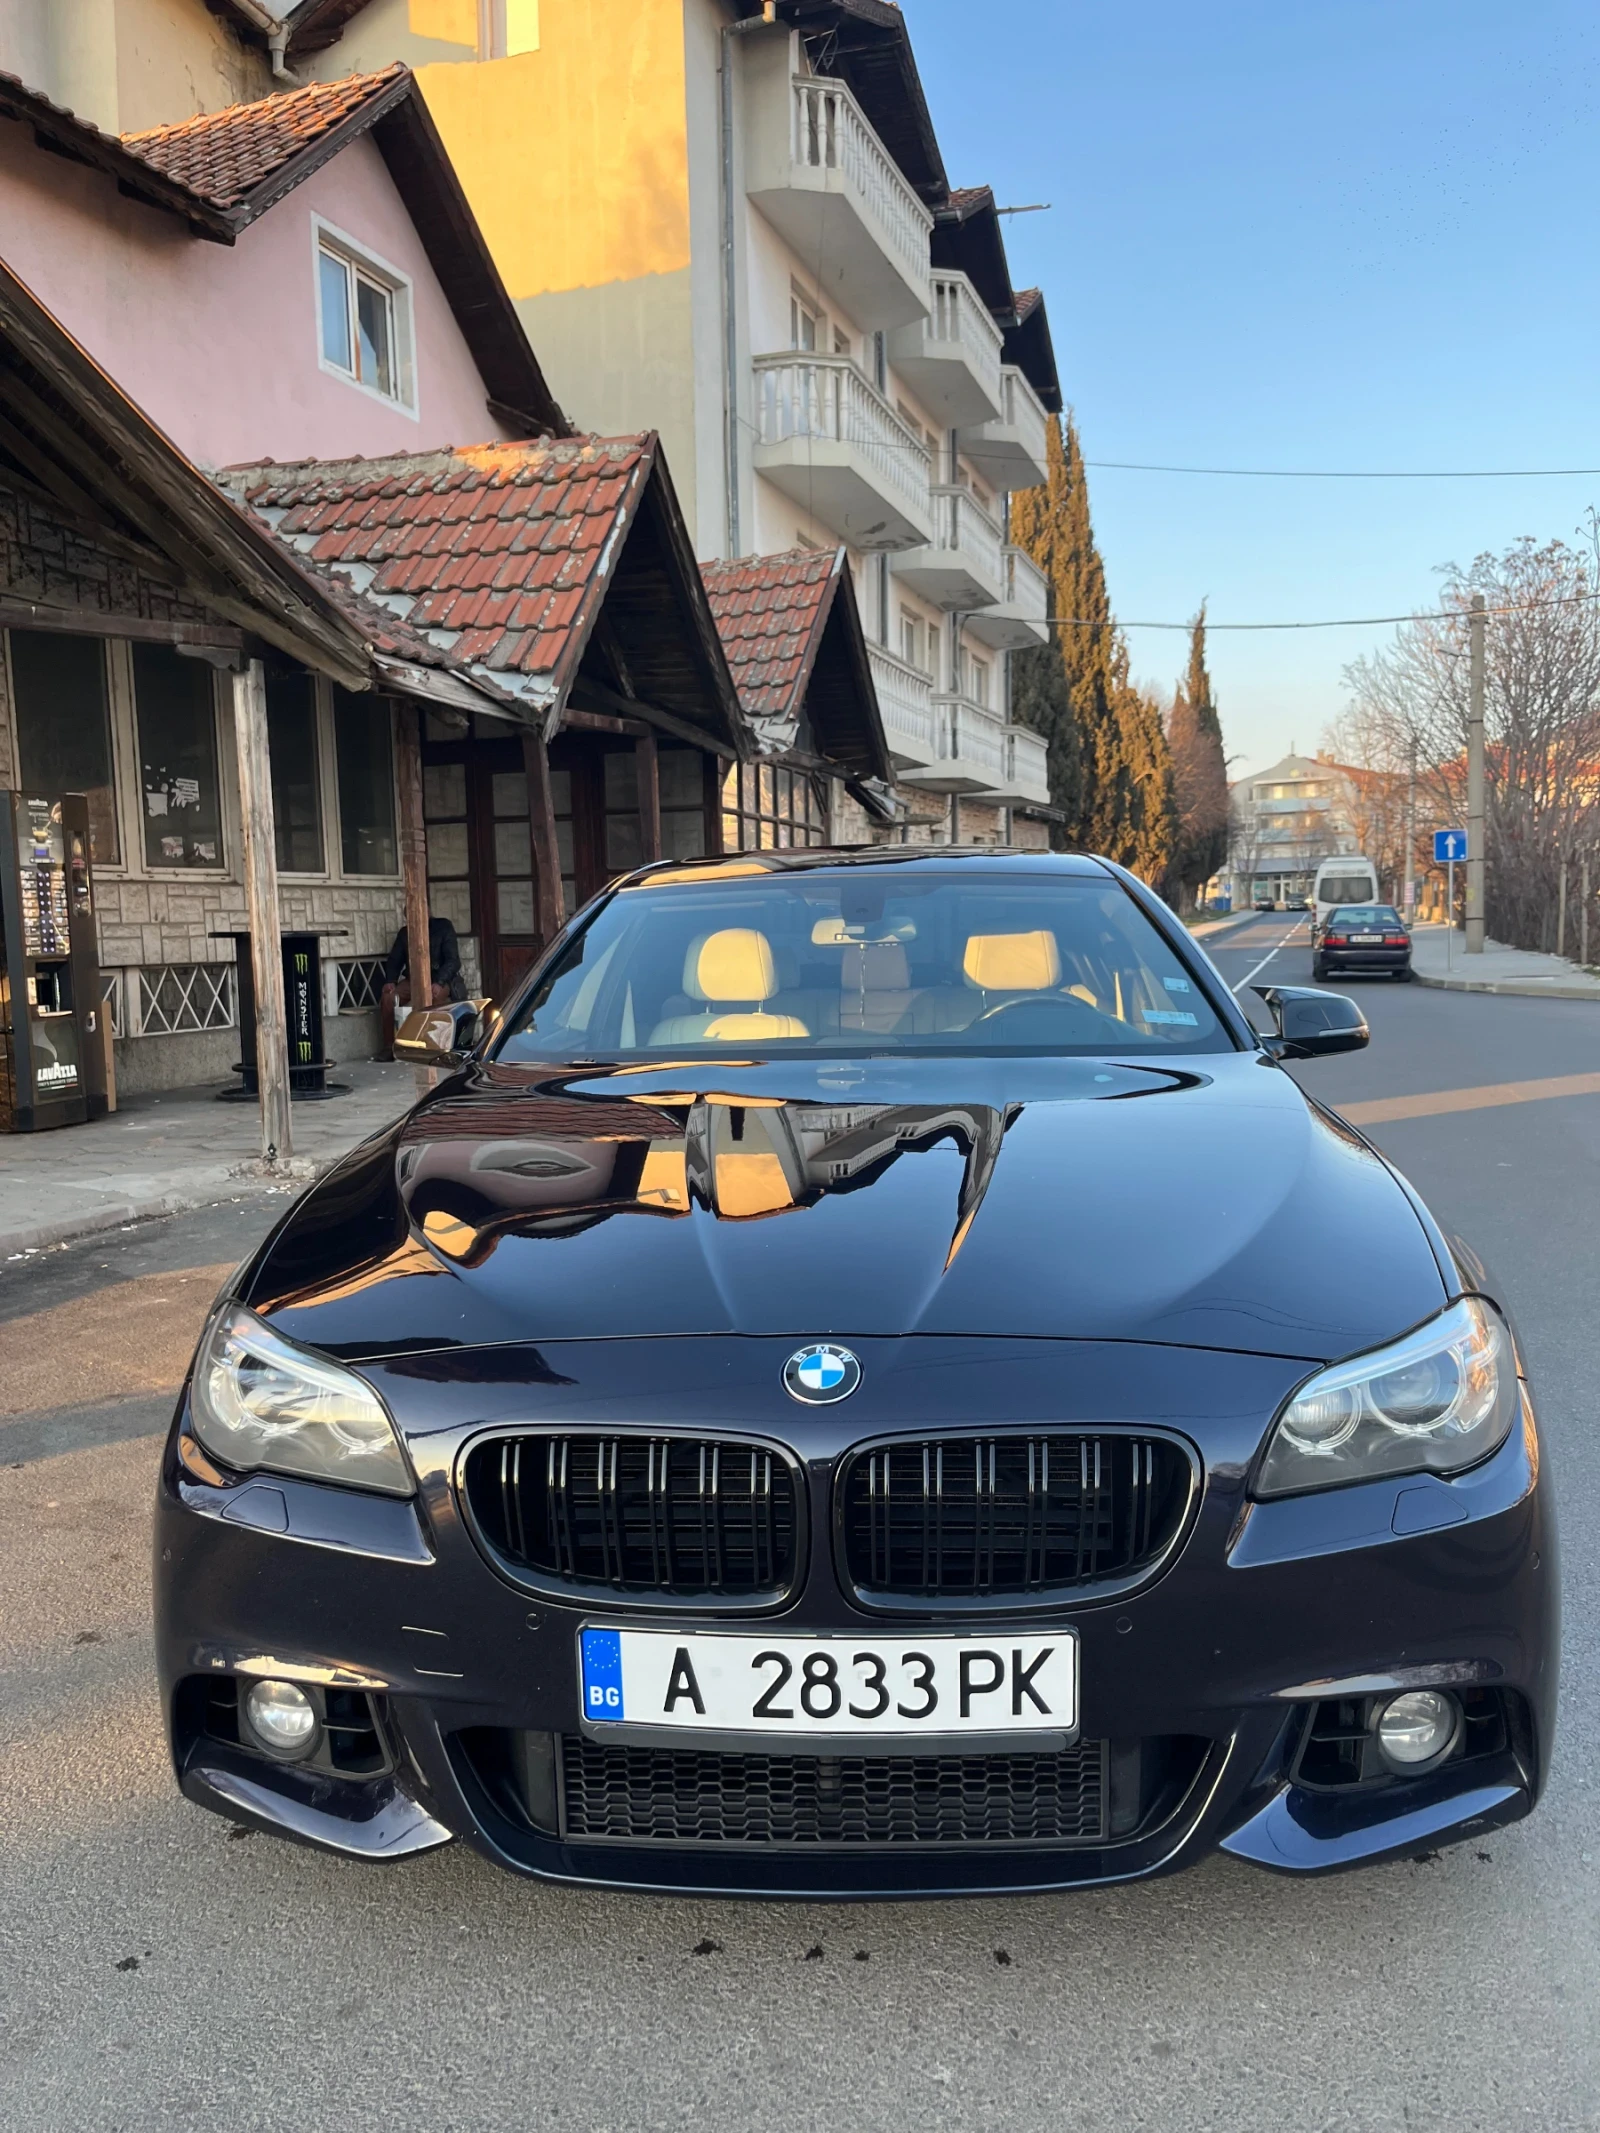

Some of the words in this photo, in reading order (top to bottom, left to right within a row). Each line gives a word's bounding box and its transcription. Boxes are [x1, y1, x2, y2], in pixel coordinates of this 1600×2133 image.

[298, 981, 309, 1036] MONSTER
[37, 1061, 78, 1081] LAVAZZA
[792, 1345, 854, 1363] BMW
[663, 1647, 706, 1714] A
[751, 1650, 939, 1719] 2833
[959, 1648, 1056, 1718] PK
[589, 1685, 620, 1707] BG
